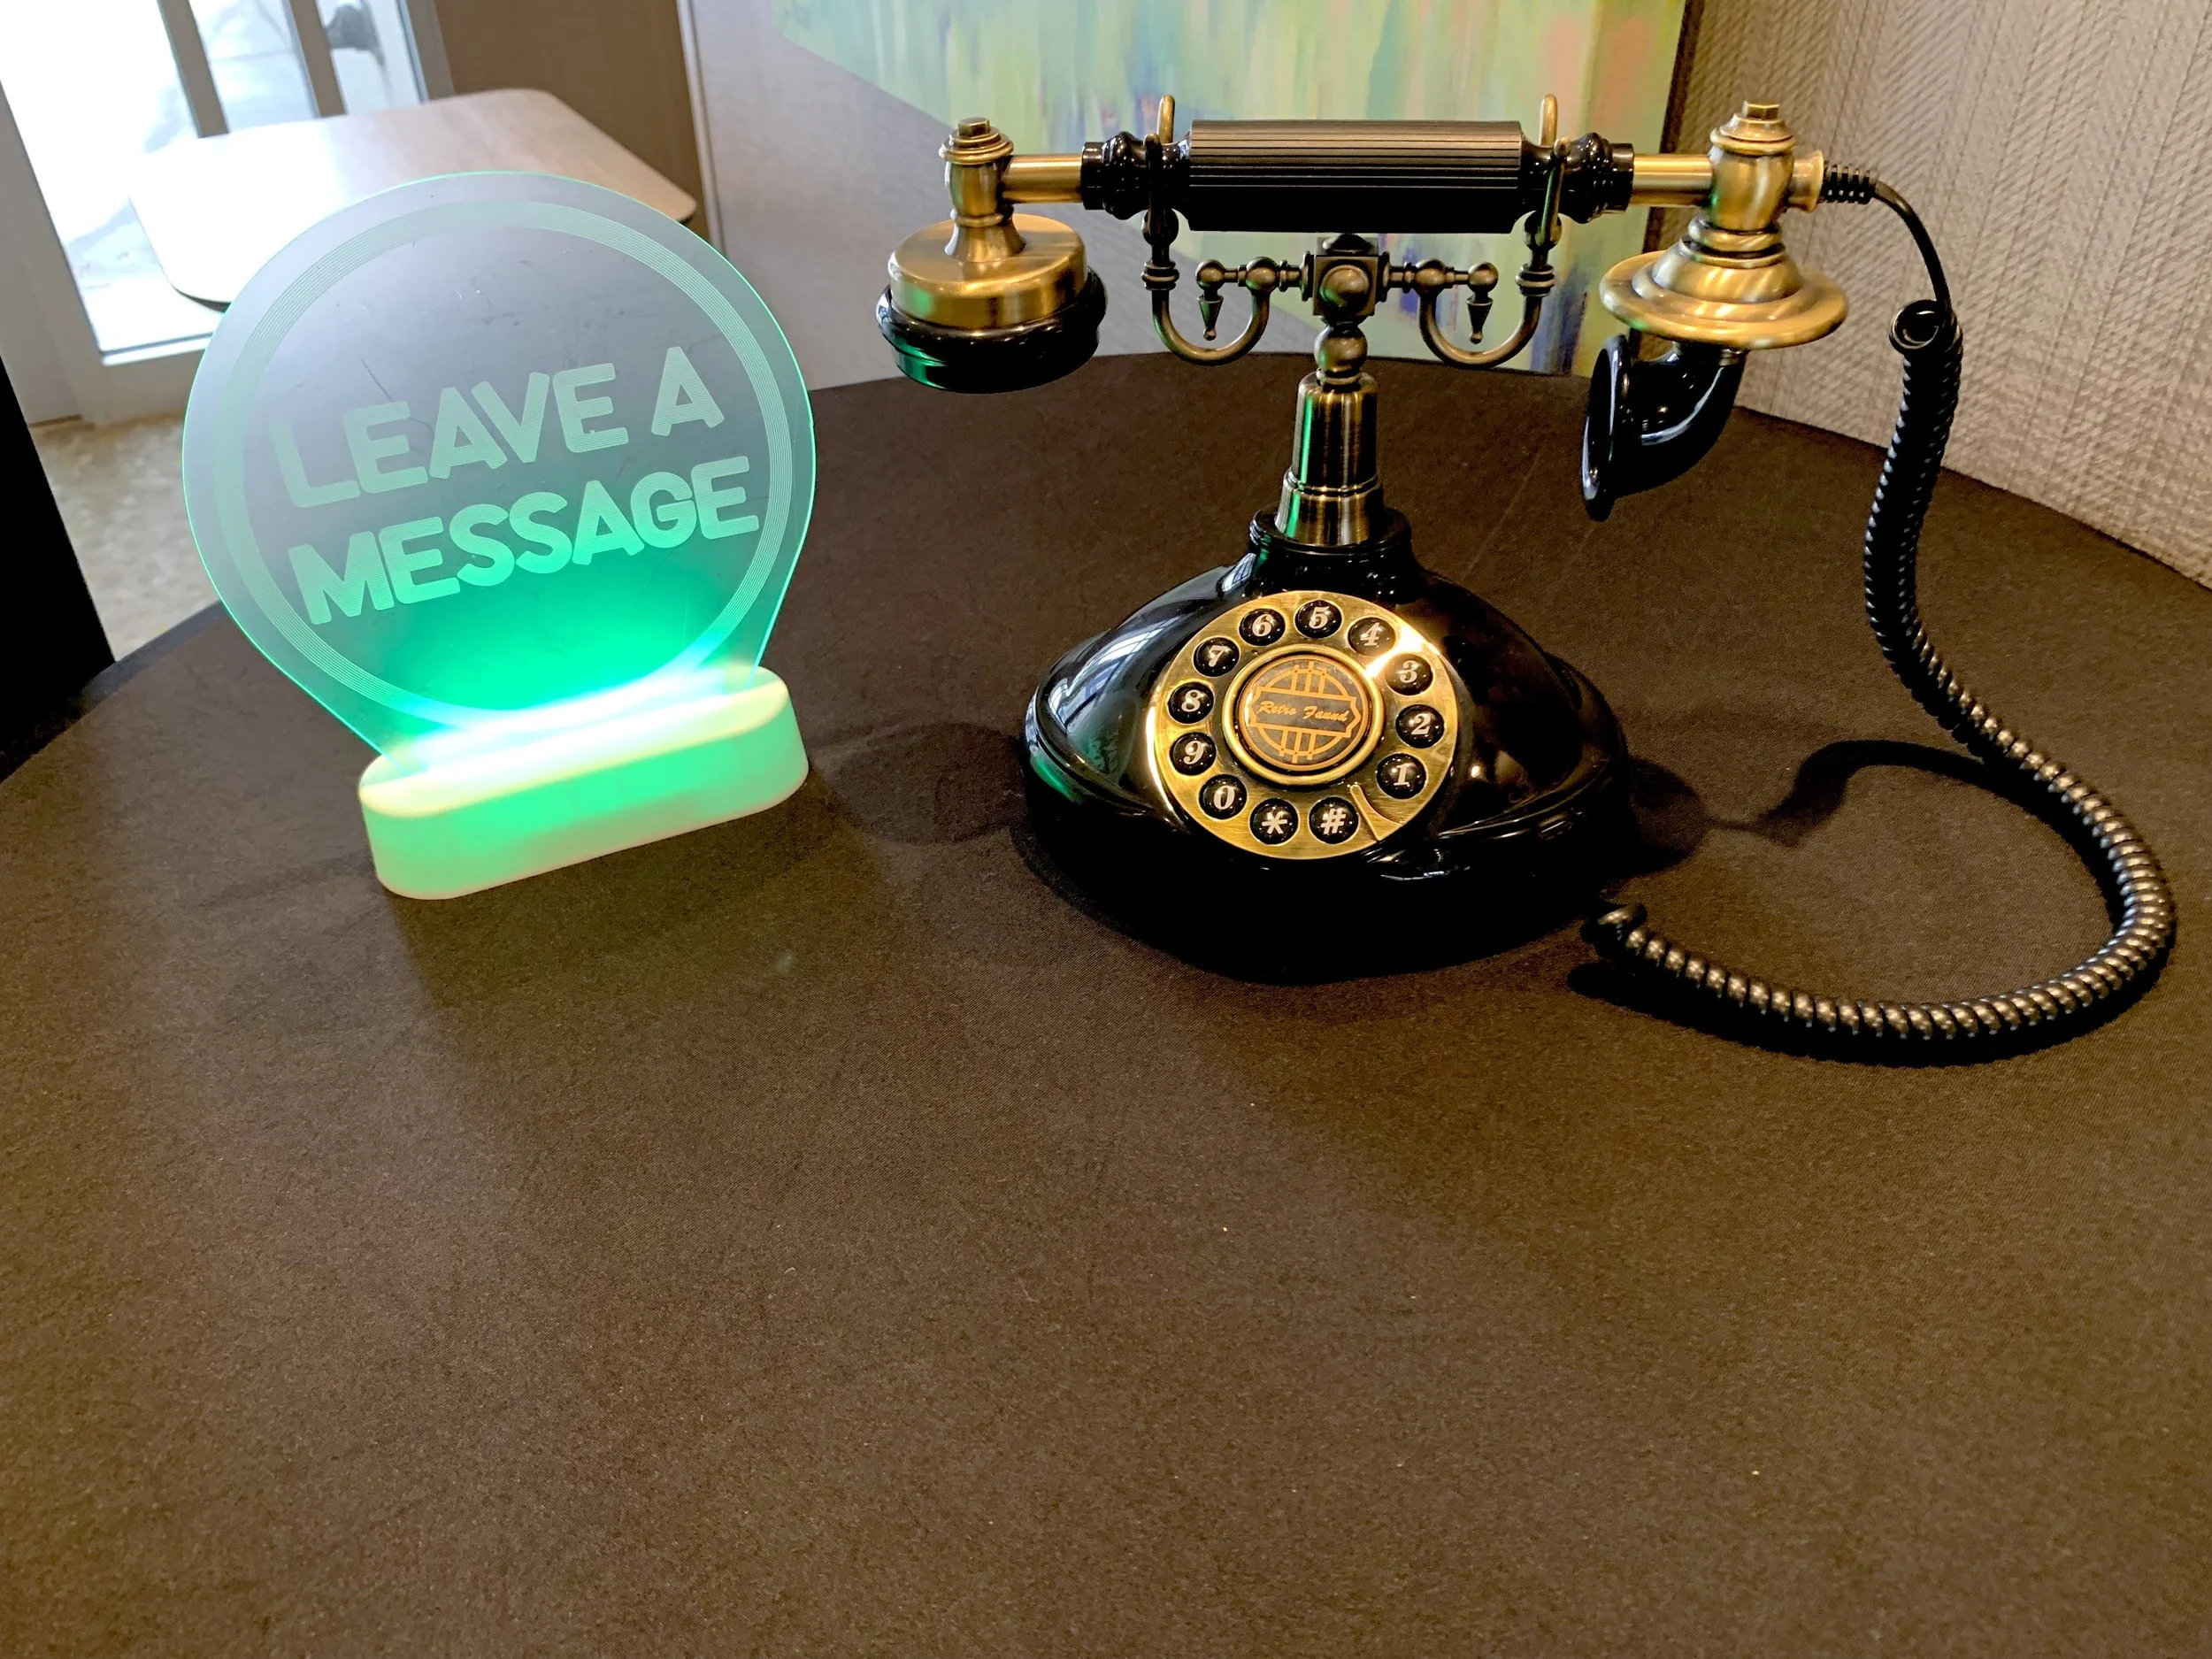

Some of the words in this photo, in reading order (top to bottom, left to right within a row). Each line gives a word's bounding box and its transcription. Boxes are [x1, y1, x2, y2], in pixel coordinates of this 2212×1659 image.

[273, 361, 629, 508] LEAVE
[651, 346, 725, 436] A
[288, 456, 760, 625] MESSAGE
[1252, 613, 1272, 637] 6
[1309, 606, 1329, 629] 5
[1360, 622, 1380, 646] 4
[1208, 645, 1225, 668] 7
[1400, 660, 1417, 683] 3
[1181, 689, 1201, 712] 8
[1256, 700, 1296, 715] Retro
[1410, 714, 1432, 736] 2
[1184, 741, 1205, 764] 9
[1393, 763, 1410, 787] 1
[1213, 786, 1235, 810] 0
